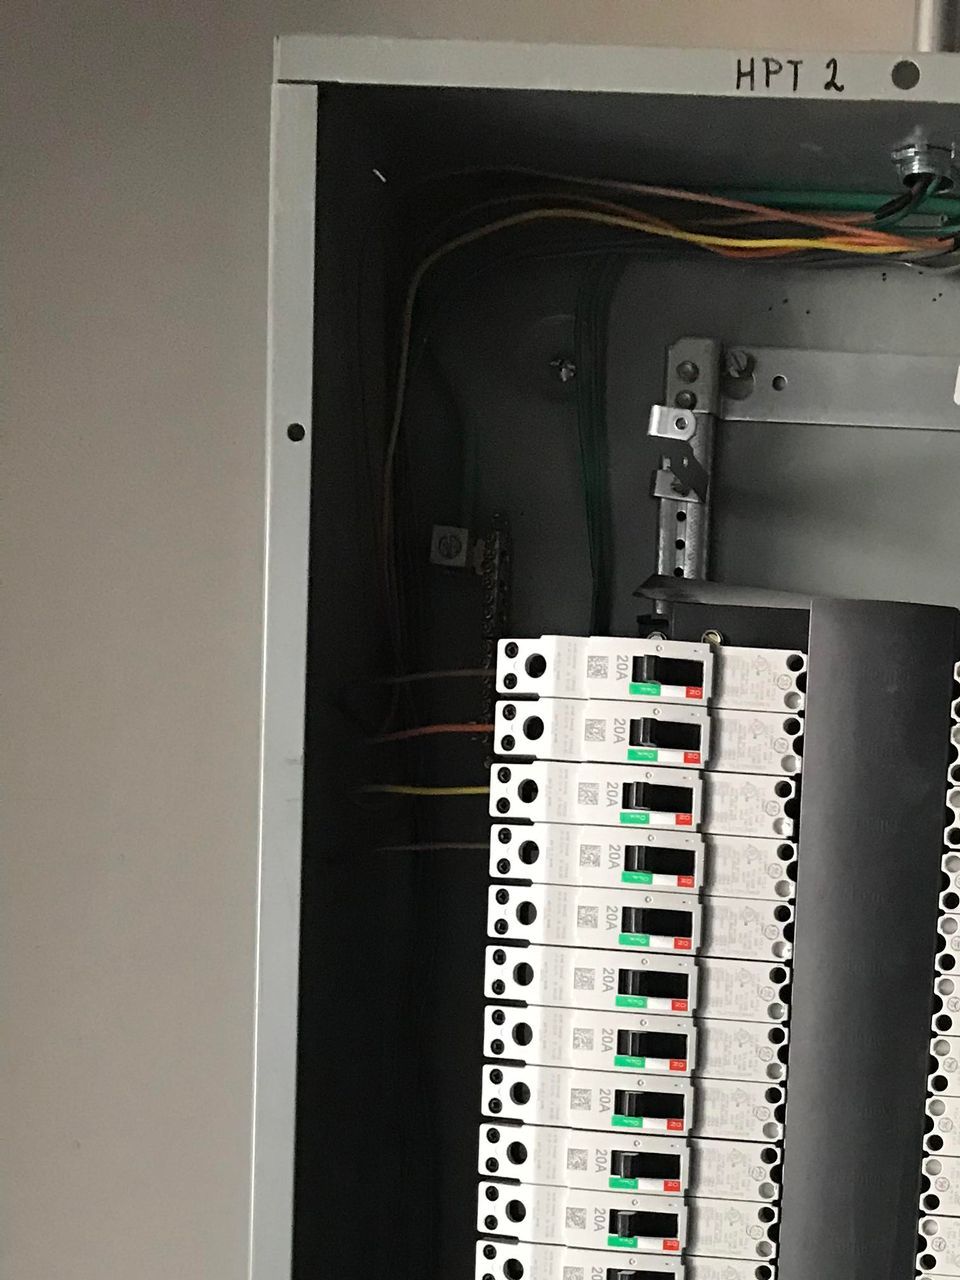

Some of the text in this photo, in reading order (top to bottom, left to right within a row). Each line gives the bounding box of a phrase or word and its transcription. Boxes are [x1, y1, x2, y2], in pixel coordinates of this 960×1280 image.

[736, 57, 844, 92] HPT 2
[616, 655, 628, 680] 20A
[614, 718, 626, 743] 20A
[607, 782, 618, 806] 20A
[609, 845, 621, 869] 20A
[607, 906, 618, 930] 20A
[603, 968, 614, 992] 20A
[602, 1029, 613, 1052] 20A
[599, 1089, 611, 1112] 20A
[596, 1149, 607, 1172] 20A
[594, 1208, 605, 1231] 20A
